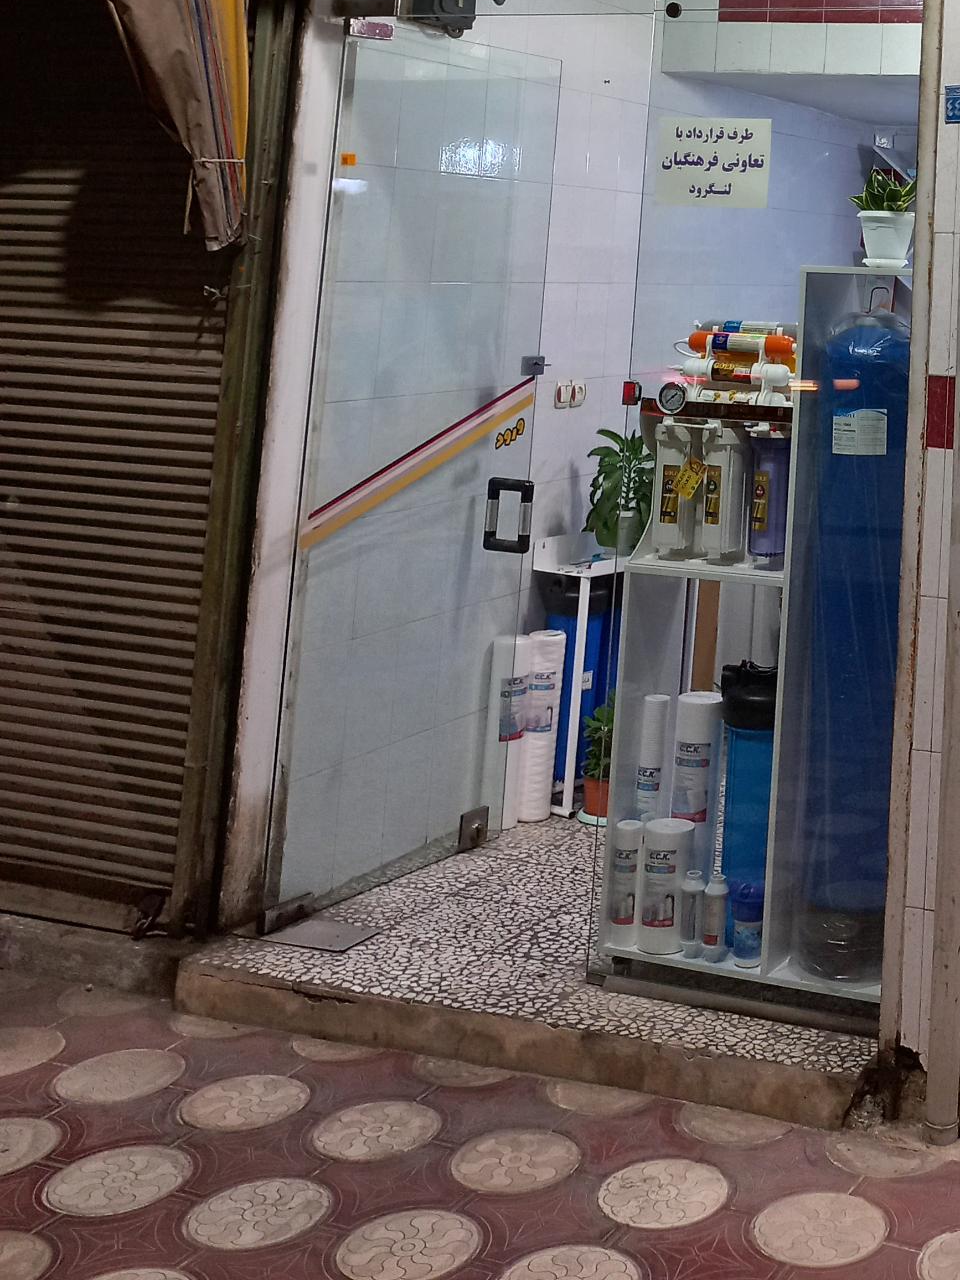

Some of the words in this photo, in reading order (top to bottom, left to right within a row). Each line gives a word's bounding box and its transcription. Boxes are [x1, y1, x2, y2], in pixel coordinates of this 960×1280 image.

[675, 126, 684, 141] با
[686, 126, 725, 143] قرارداد
[727, 127, 754, 144] طرف
[661, 150, 719, 172] فرهنگیان
[722, 152, 765, 173] تعاونی
[689, 182, 732, 198] لنگرود
